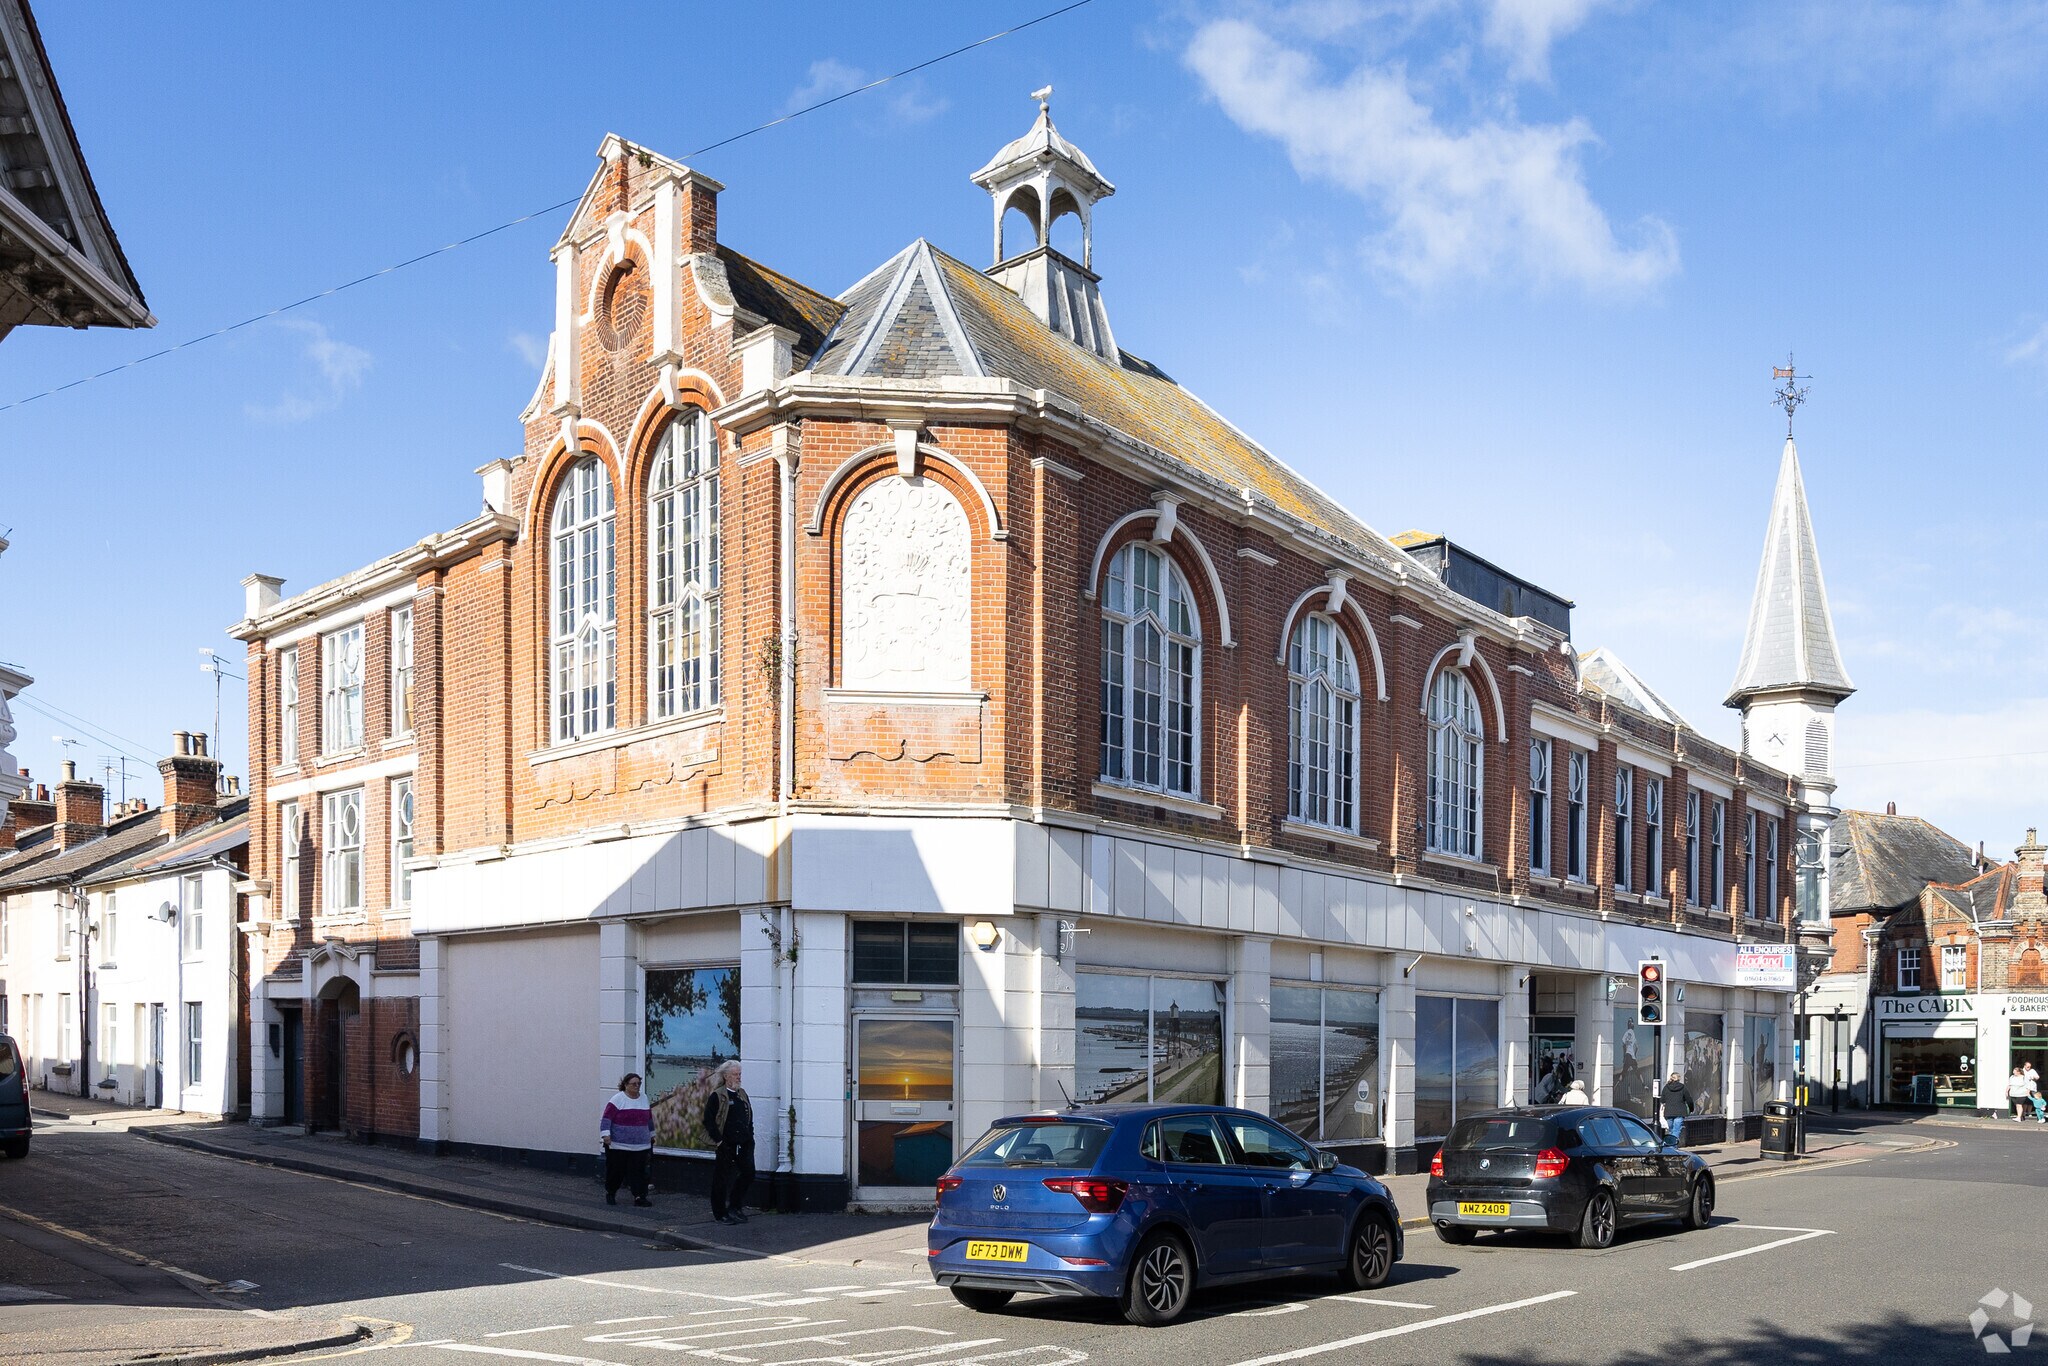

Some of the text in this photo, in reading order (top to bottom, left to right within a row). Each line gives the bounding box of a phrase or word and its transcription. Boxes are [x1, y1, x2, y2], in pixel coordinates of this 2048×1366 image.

[1740, 946, 1792, 954] ALL ENQUIRIES
[1739, 955, 1782, 965] Hadland
[1881, 998, 1974, 1014] The CABIN
[1463, 1204, 1505, 1214] AMZ 2409
[971, 1244, 1023, 1260] GF73 DWM
